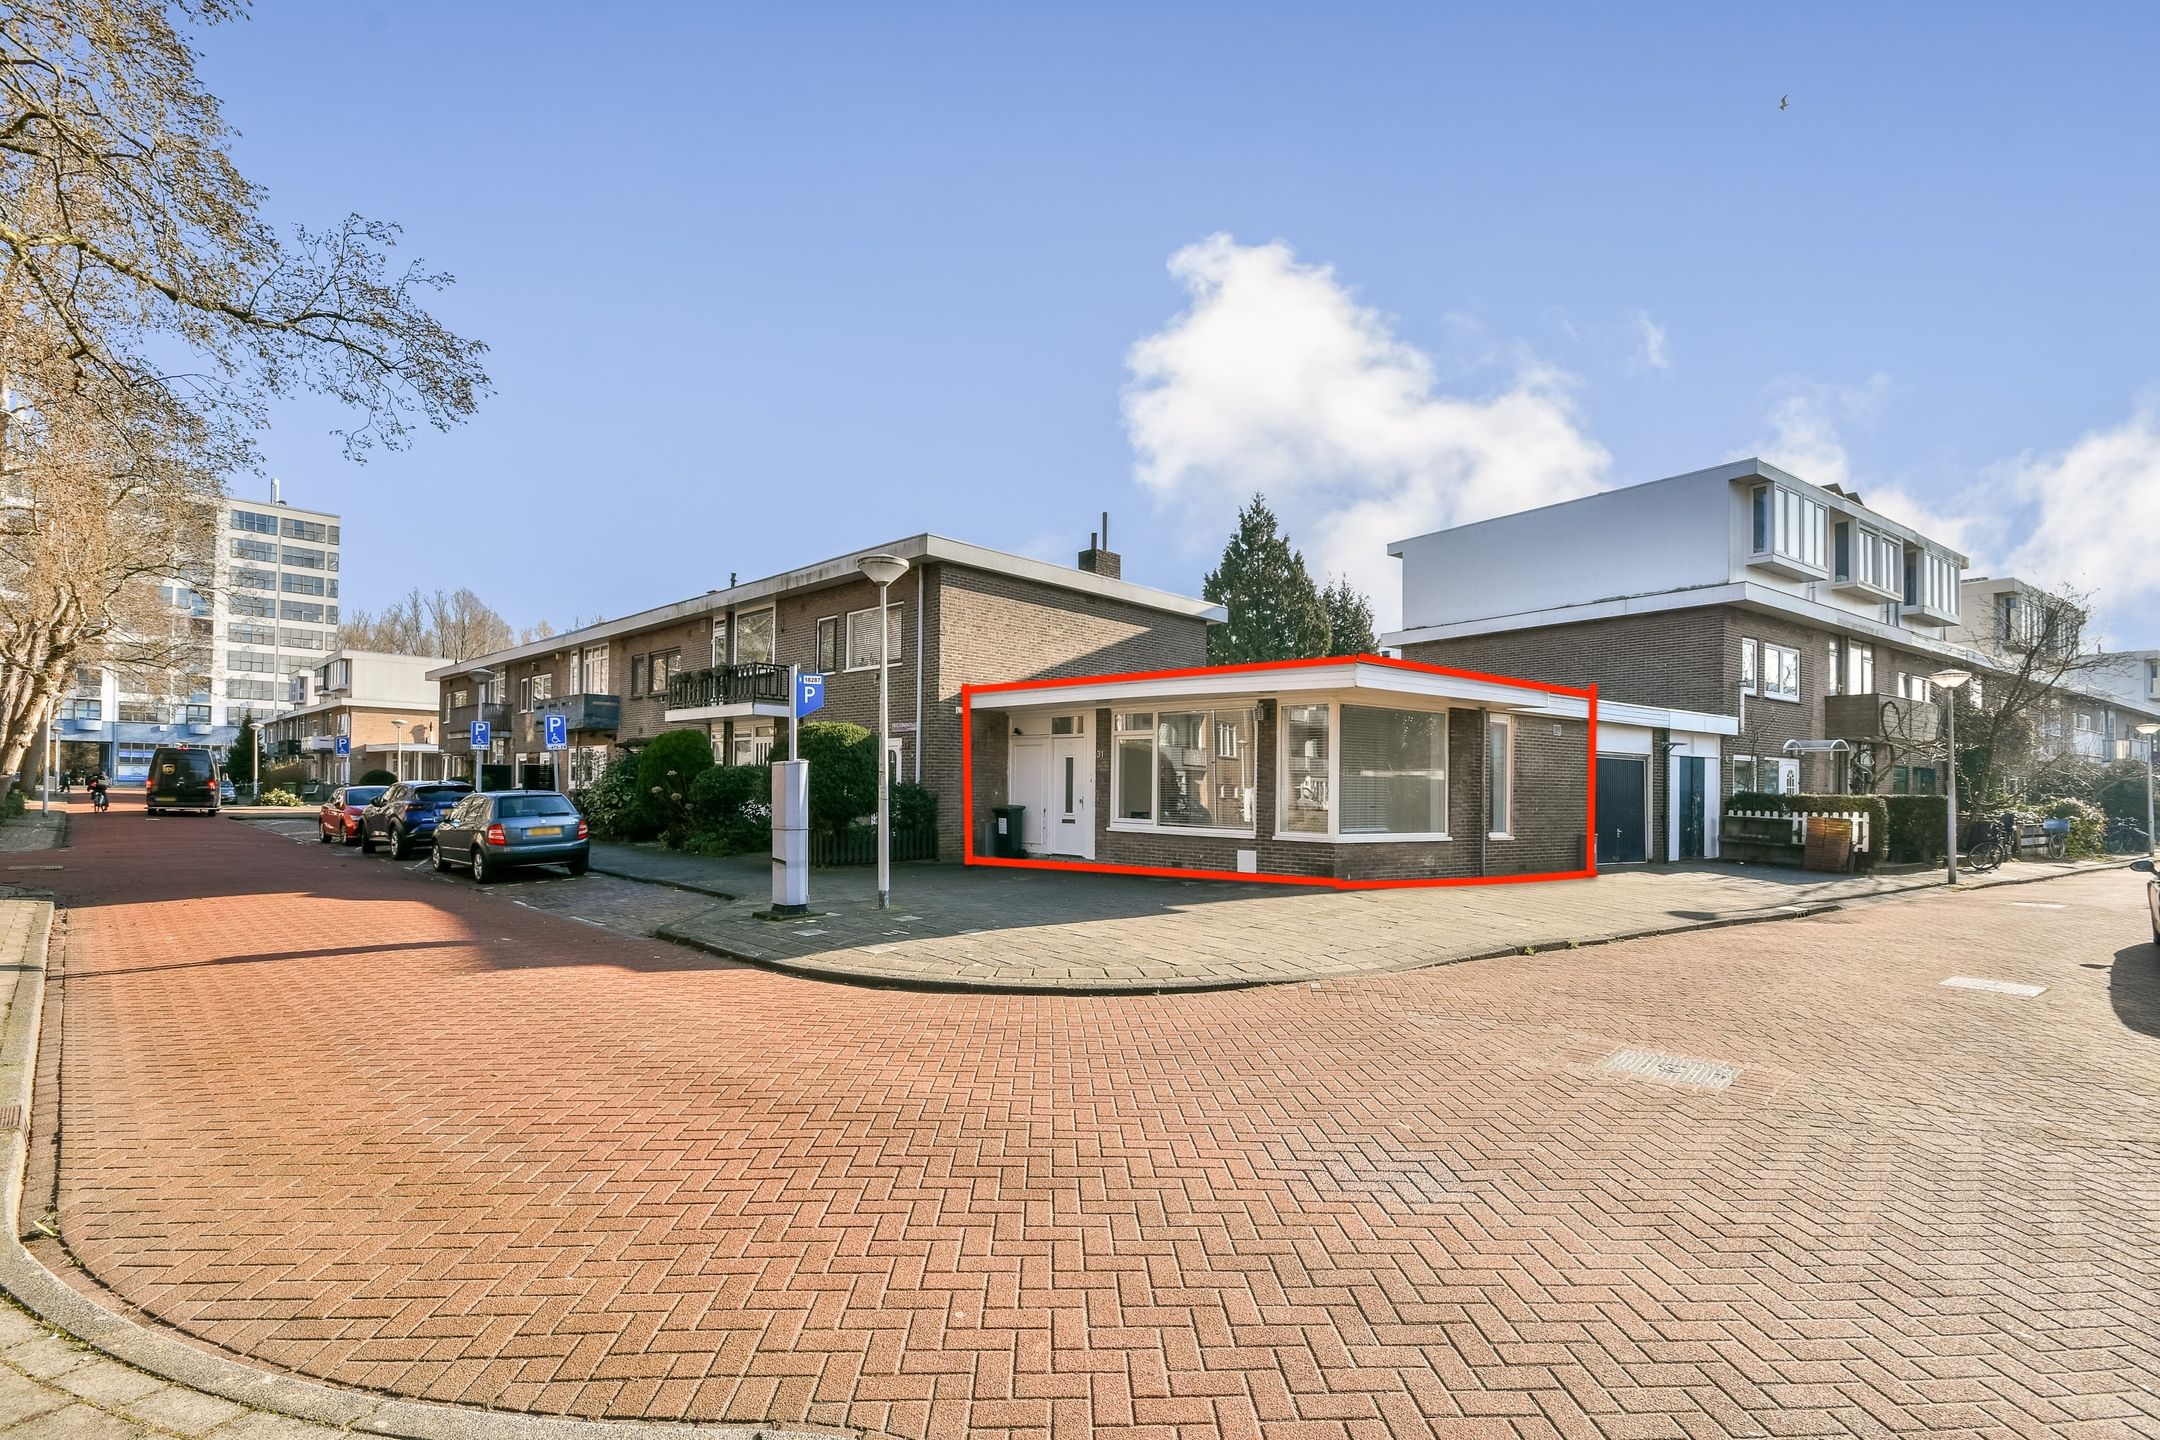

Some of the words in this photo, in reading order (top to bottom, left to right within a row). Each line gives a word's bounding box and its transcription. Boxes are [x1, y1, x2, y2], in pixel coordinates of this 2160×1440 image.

[804, 686, 816, 704] P
[475, 723, 486, 735] P
[549, 717, 562, 733] P
[339, 738, 347, 748] P
[1096, 750, 1104, 759] 31
